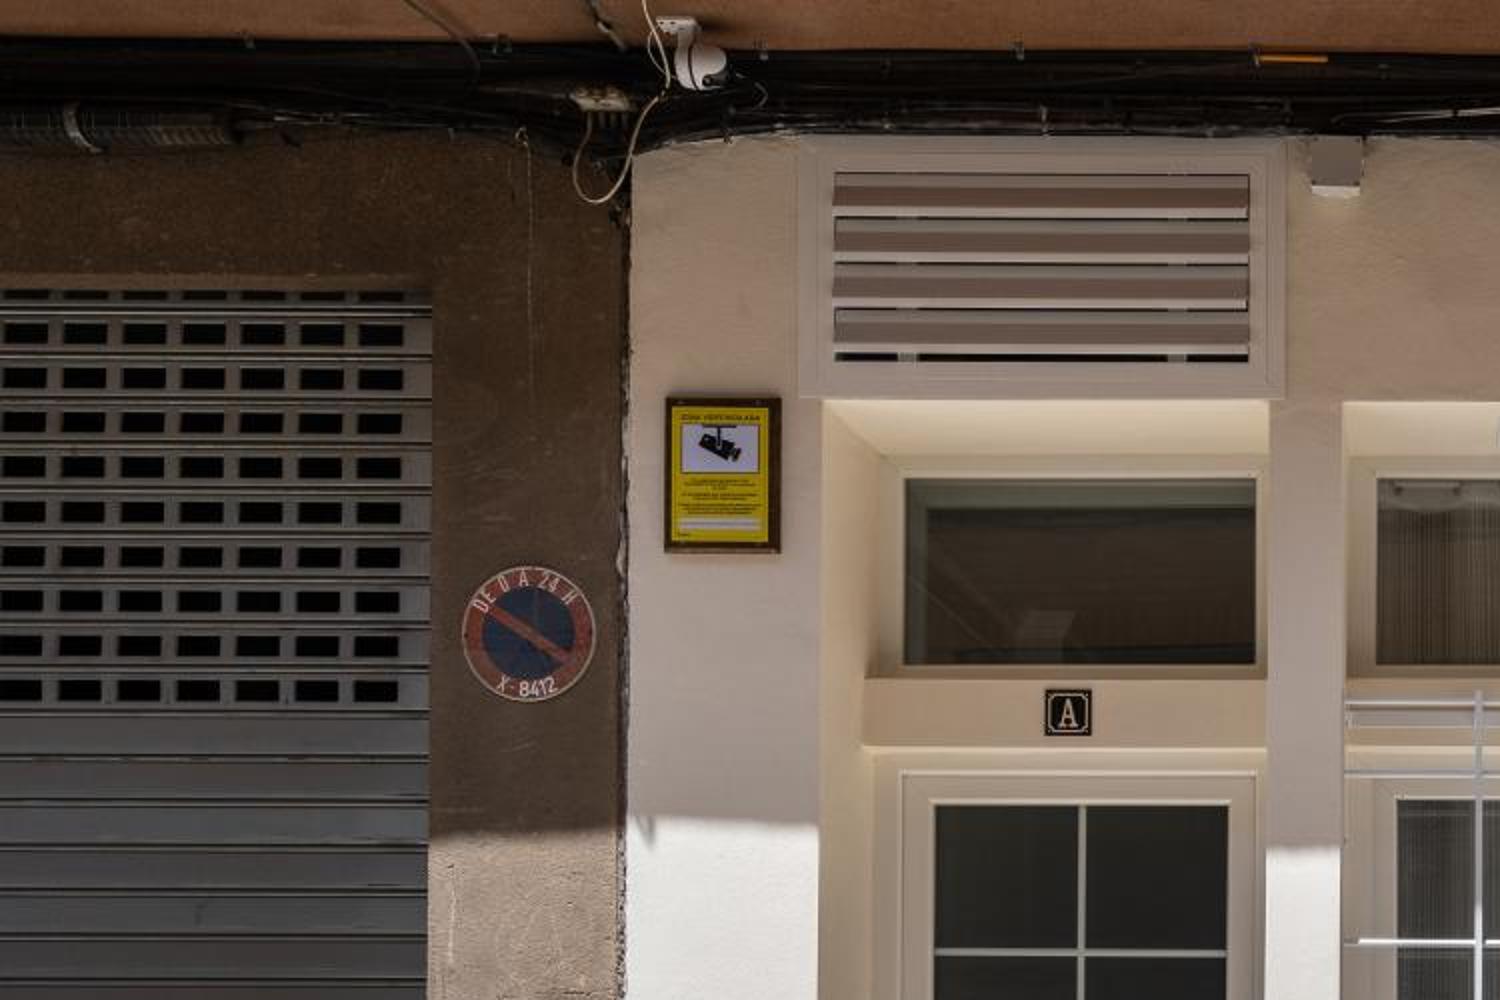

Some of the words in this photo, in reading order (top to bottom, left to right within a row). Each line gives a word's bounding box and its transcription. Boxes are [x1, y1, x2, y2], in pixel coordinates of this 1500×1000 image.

[472, 588, 496, 614] DE
[518, 569, 529, 587] A
[537, 570, 560, 592] 24
[1058, 698, 1079, 728] A
